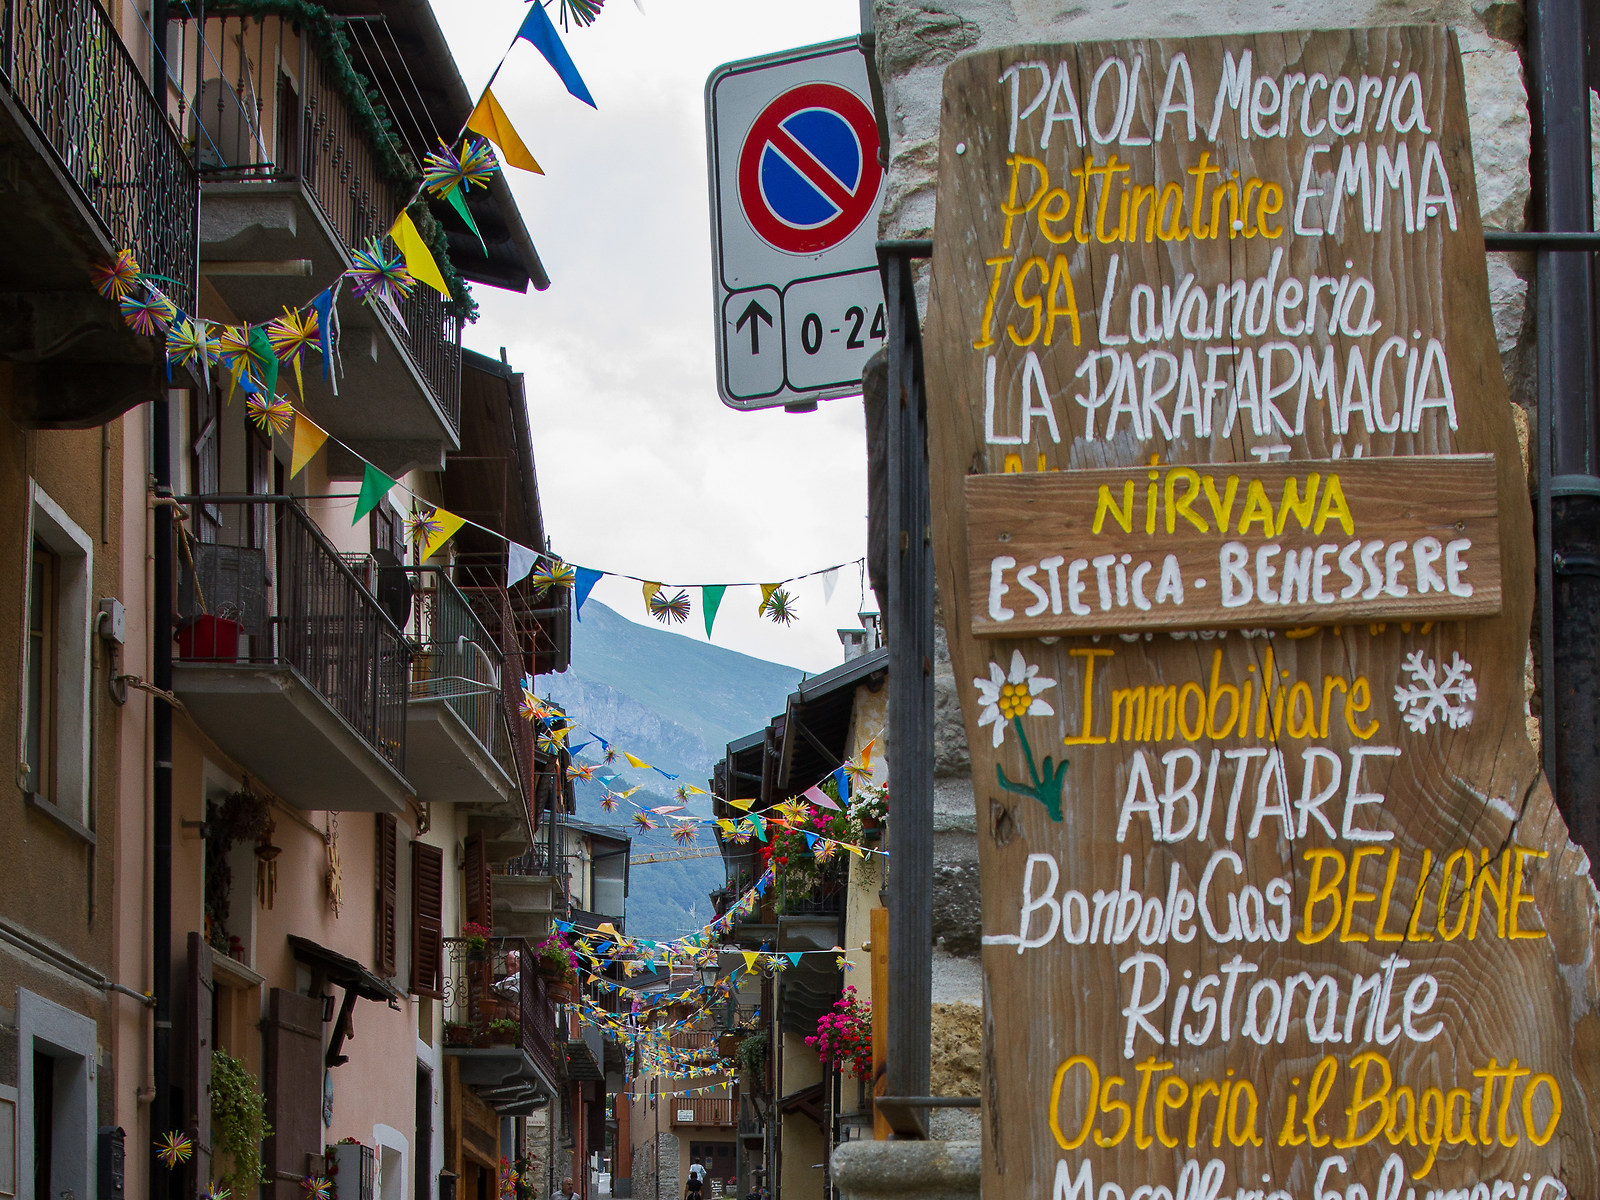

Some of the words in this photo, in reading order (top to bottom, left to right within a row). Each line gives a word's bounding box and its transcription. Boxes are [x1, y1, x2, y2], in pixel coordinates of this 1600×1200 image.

[998, 50, 1197, 152] PAOLA
[1208, 48, 1432, 142] Merceria
[1000, 151, 1284, 249] Pettinatrice
[1295, 140, 1457, 237] EMMA
[973, 253, 1081, 349] ISA
[1098, 246, 1382, 346] Lavanderia
[985, 350, 1061, 446] LA
[1219, 535, 1474, 608] BENESSERE
[1063, 645, 1381, 746] Immobiliare
[1116, 746, 1402, 844] ABITARE
[1296, 845, 1550, 946] BELLONE
[1119, 951, 1443, 1059] Ristorante
[1049, 1054, 1264, 1151] Osteria
[1278, 1055, 1338, 1147] il
[1333, 1051, 1563, 1180] Bagatto
